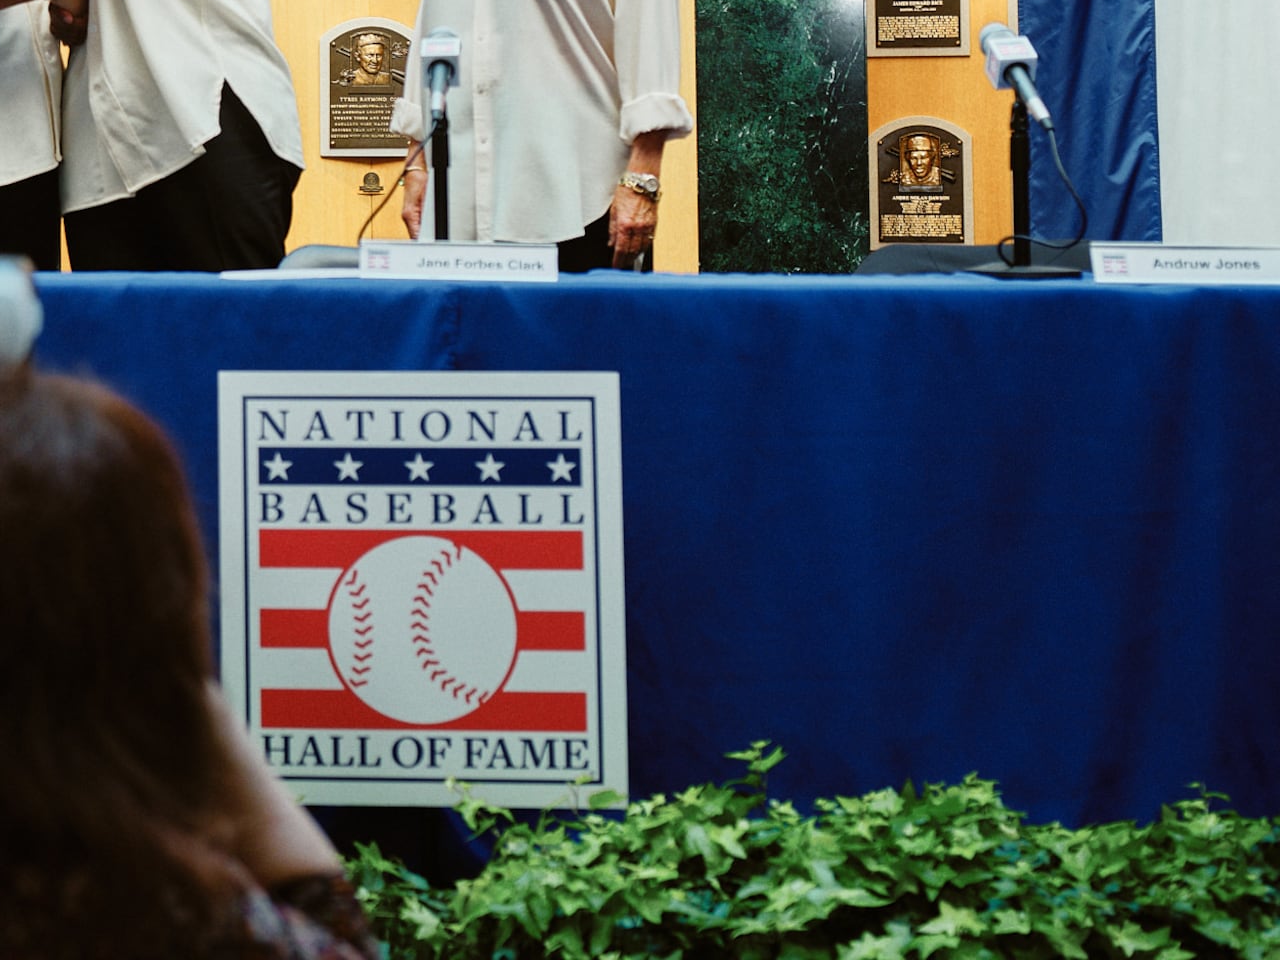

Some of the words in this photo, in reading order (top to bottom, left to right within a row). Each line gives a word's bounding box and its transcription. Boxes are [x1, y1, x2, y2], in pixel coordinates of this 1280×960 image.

[418, 257, 450, 268] Jane
[456, 258, 503, 270] Forbes
[508, 259, 544, 271] Clark
[1153, 258, 1211, 270] Andruw
[1215, 259, 1261, 270] Jones
[258, 409, 583, 442] NATIONAL
[258, 492, 585, 525] BASEBALL
[262, 735, 381, 768] HALL
[391, 735, 452, 769] OF
[463, 737, 590, 771] FAME
